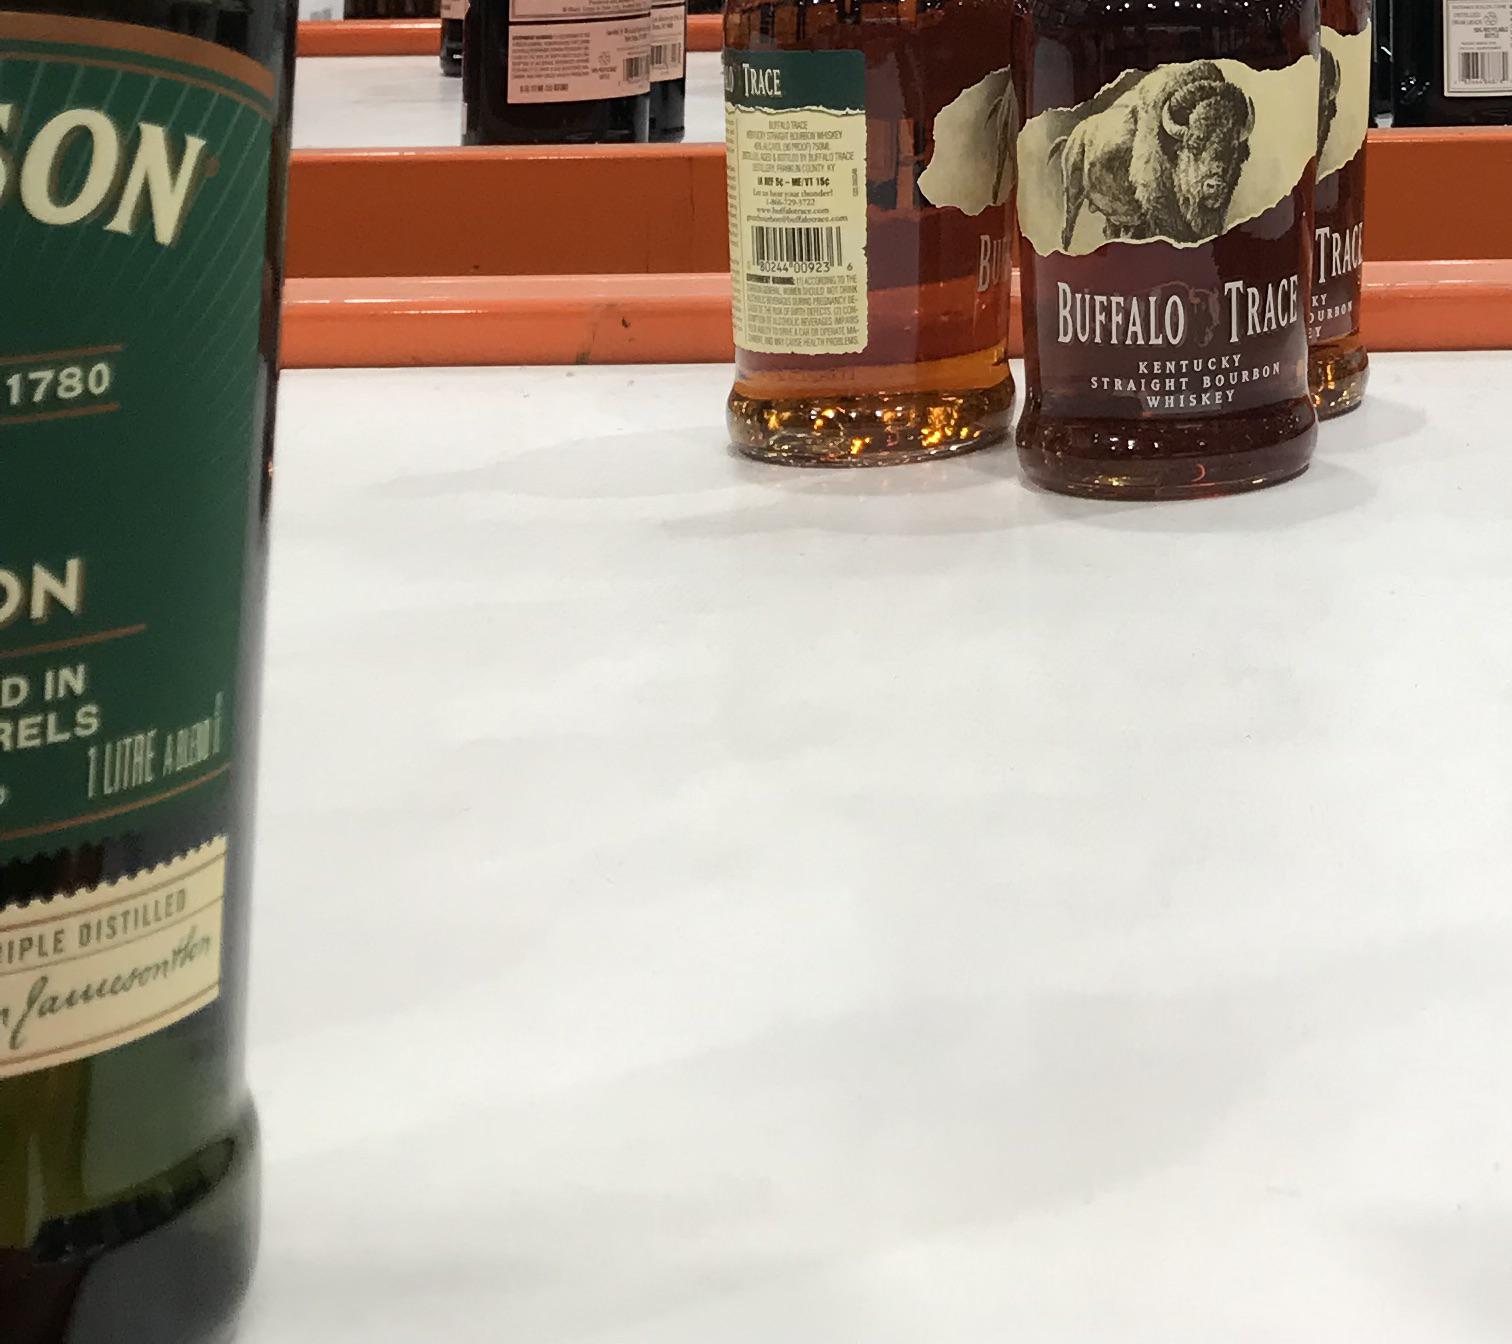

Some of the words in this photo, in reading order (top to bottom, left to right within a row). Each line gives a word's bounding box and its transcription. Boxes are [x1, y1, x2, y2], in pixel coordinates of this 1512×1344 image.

[742, 63, 782, 97] TRACE
[0, 102, 207, 247] ON
[793, 261, 830, 273] 00923
[846, 262, 854, 272] 6
[1056, 280, 1186, 346] BUFFALO
[1223, 273, 1299, 344] TRACE
[1090, 376, 1189, 392] STRAIGHT
[1202, 361, 1281, 389] BOURBON
[1138, 353, 1243, 375] KENTUCKY
[6, 362, 112, 406] 1780
[1146, 389, 1236, 409] WHISKEY
[44, 663, 87, 702] IN
[103, 726, 157, 795] LITRE
[0, 927, 66, 965] IPLE
[78, 886, 188, 949] DISTILLED
